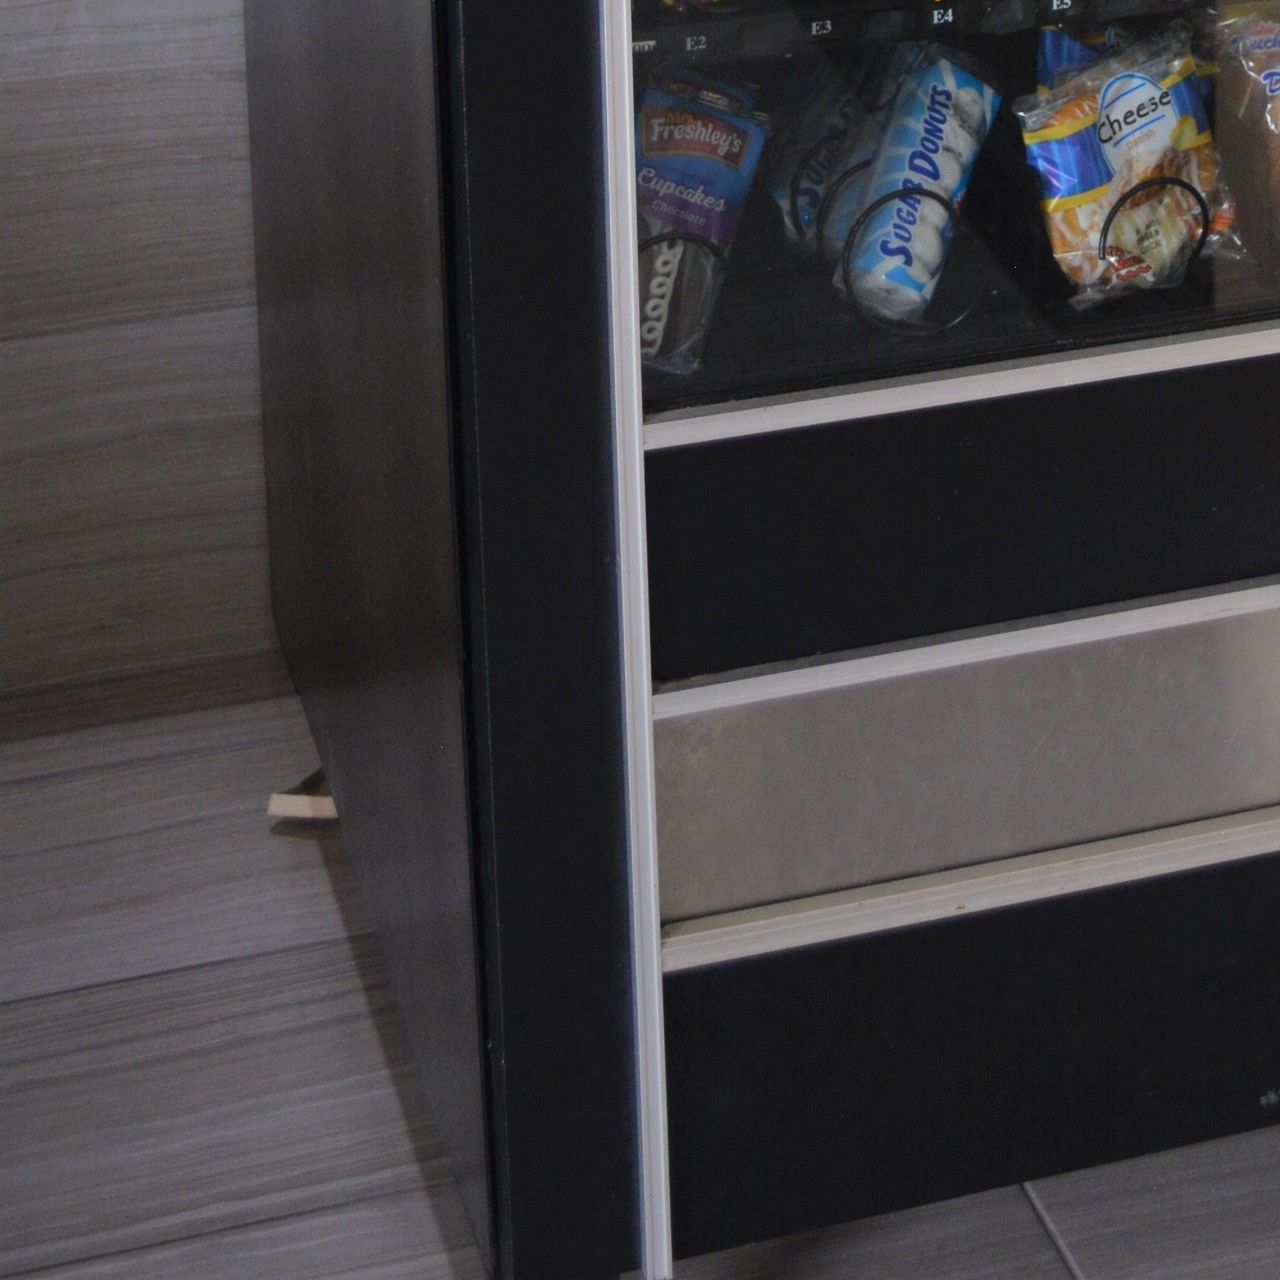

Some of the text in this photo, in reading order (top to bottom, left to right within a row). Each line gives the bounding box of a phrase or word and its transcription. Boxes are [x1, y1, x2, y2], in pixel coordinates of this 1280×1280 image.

[811, 20, 832, 35] E3
[933, 8, 954, 24] E4
[686, 35, 707, 51] E2
[651, 117, 742, 155] Freshley's
[1098, 91, 1171, 145] Cheese
[637, 167, 726, 212] Cupcakes
[880, 85, 952, 267] SUGAR DONUTS
